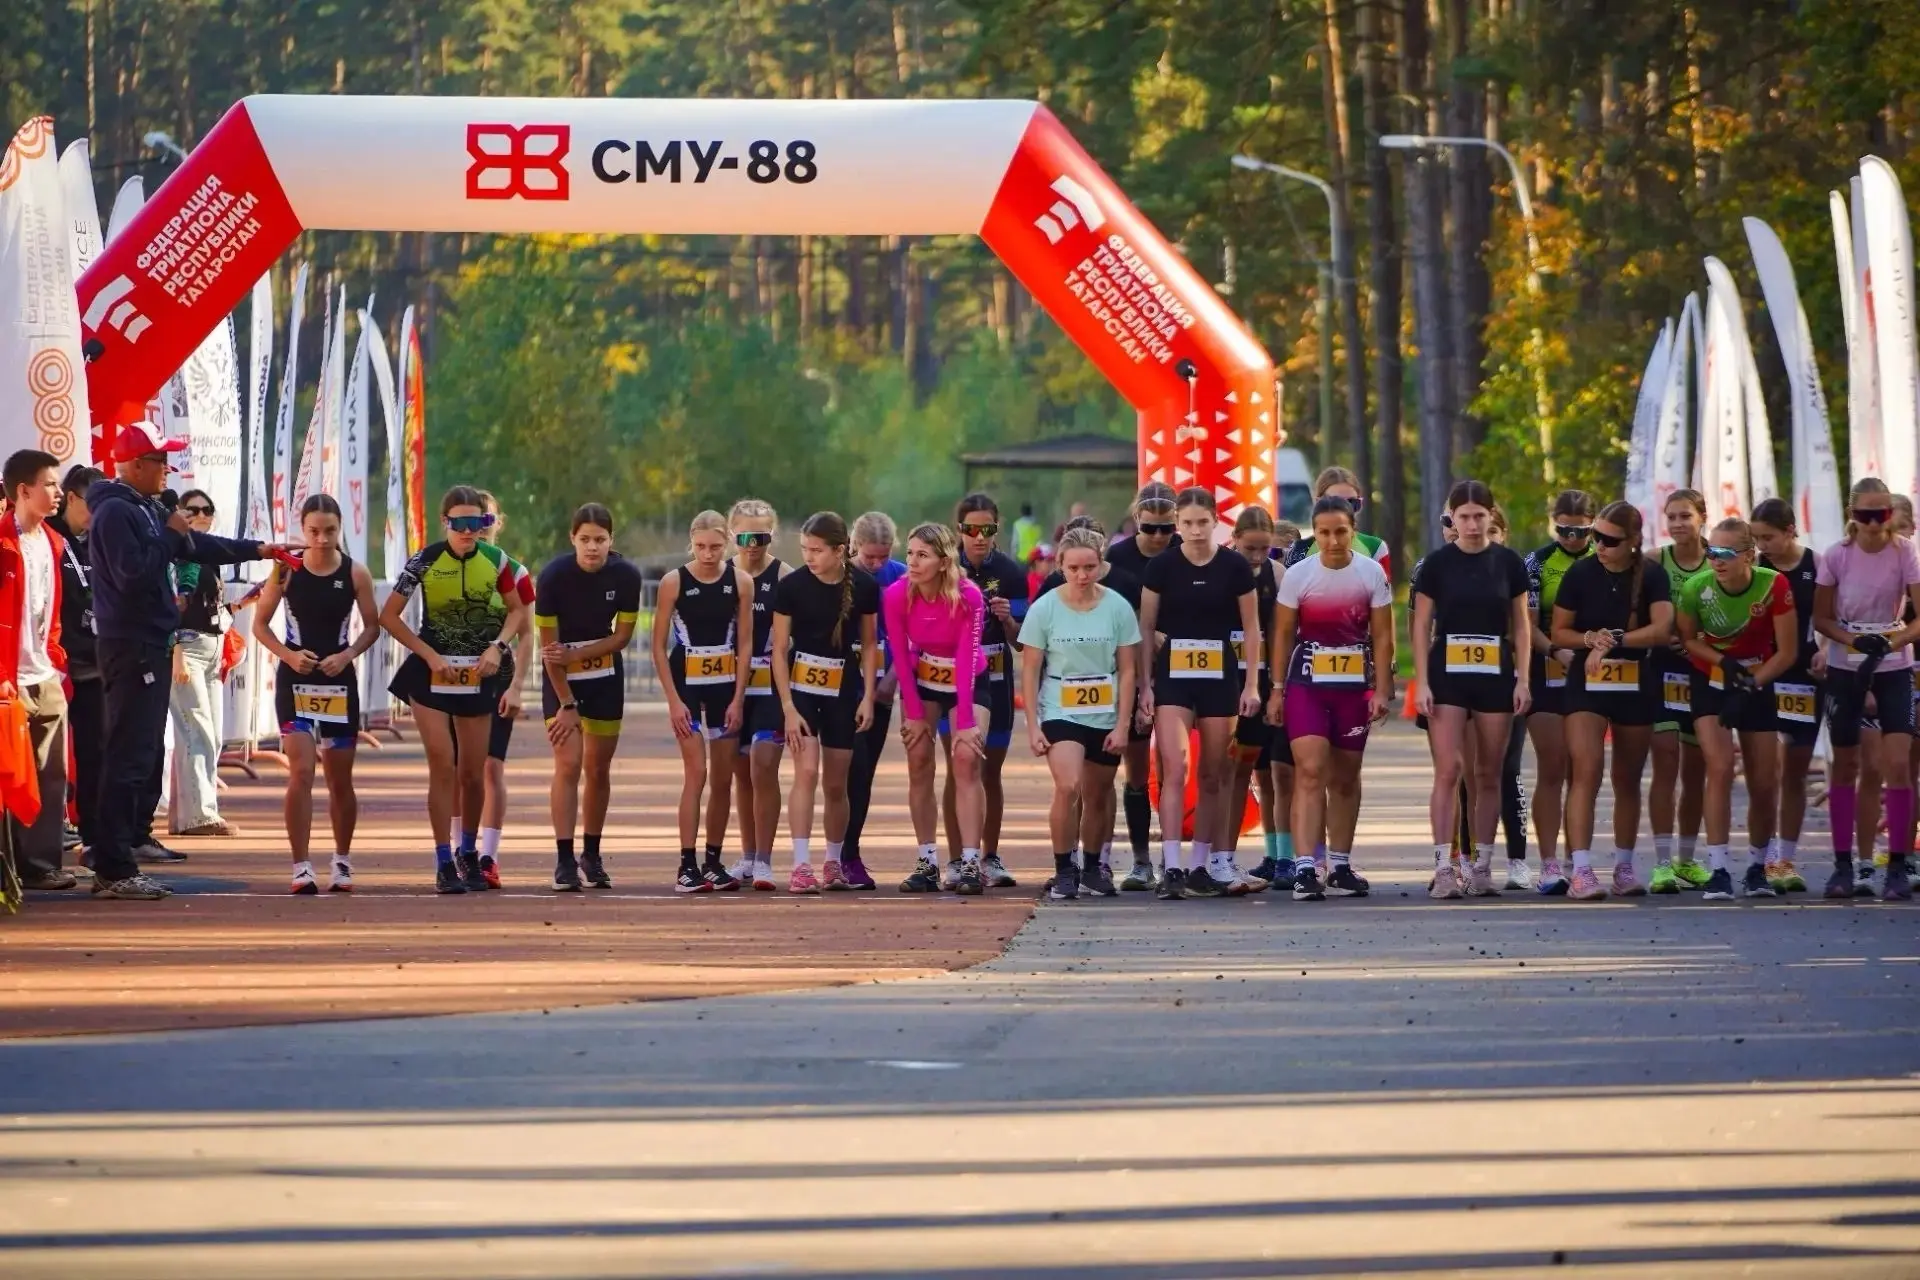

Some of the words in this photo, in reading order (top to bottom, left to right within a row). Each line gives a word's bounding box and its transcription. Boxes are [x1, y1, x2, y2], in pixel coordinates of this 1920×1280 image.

[591, 139, 818, 184] СМУ-88
[136, 174, 222, 269] ФЕДЕРАЦИЯ
[147, 190, 235, 283] ТРИАТЛОНА
[162, 191, 260, 297] РЕСПУБЛИКИ
[177, 217, 262, 308] ТАТАРСТАН
[1107, 233, 1196, 329] ФЕДЕРАЦИЯ
[1076, 257, 1174, 364] РЕСПУБЛИКИ
[1092, 244, 1178, 341] ТРИАТЛОНА
[1063, 270, 1148, 364] ТАТАРСТАН
[701, 657, 724, 675] 54
[805, 667, 828, 686] 53
[929, 666, 952, 684] 22
[1185, 651, 1208, 669] 18
[1328, 655, 1352, 673] 17
[1461, 646, 1486, 663] 19
[1601, 664, 1624, 682] 21
[309, 697, 332, 713] 57
[1076, 687, 1100, 705] 20
[1515, 774, 1528, 837] adidas
